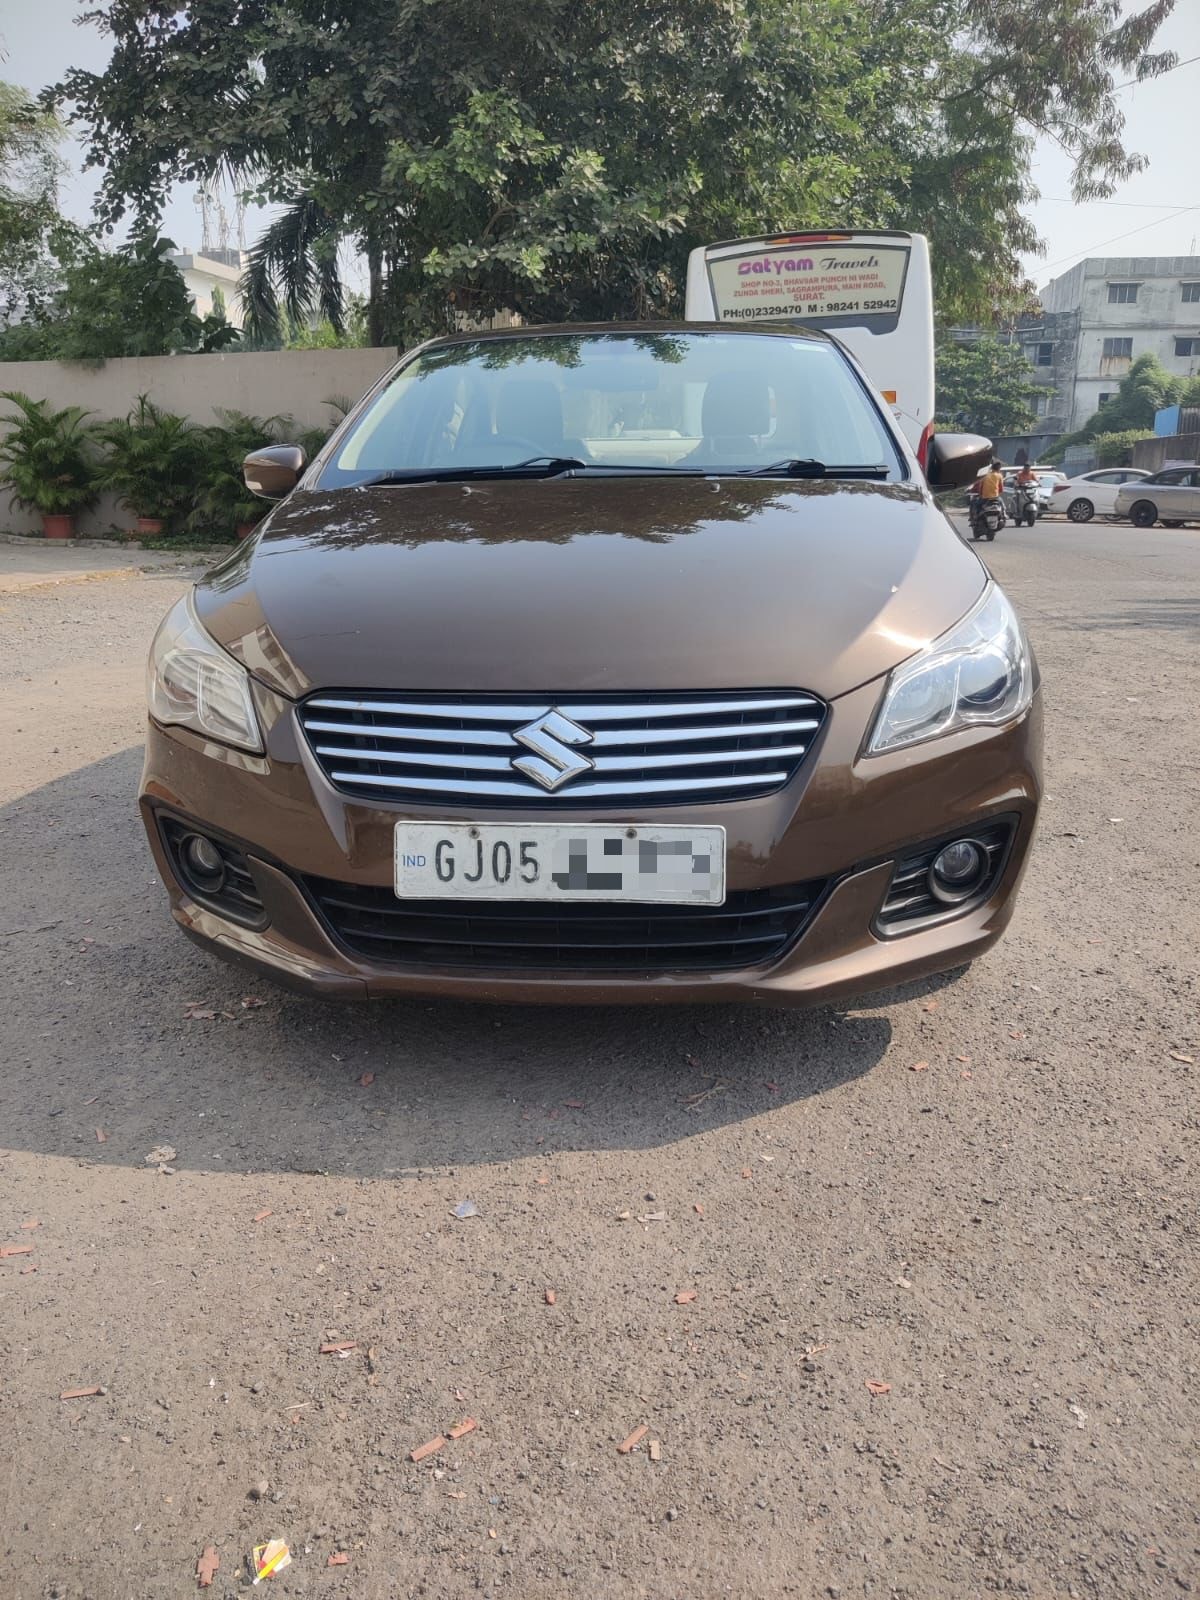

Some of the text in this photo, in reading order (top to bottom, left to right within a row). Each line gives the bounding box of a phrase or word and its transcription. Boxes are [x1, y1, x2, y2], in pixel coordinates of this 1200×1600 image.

[819, 255, 879, 271] Travels
[741, 280, 761, 288] SHOP
[820, 274, 847, 283] PUNCH
[723, 304, 802, 319] PH:(0)2329470
[807, 303, 818, 313] M
[826, 301, 860, 312] 98241
[863, 299, 897, 310] 52942
[402, 855, 426, 867] IND
[435, 839, 540, 884] GJ05
